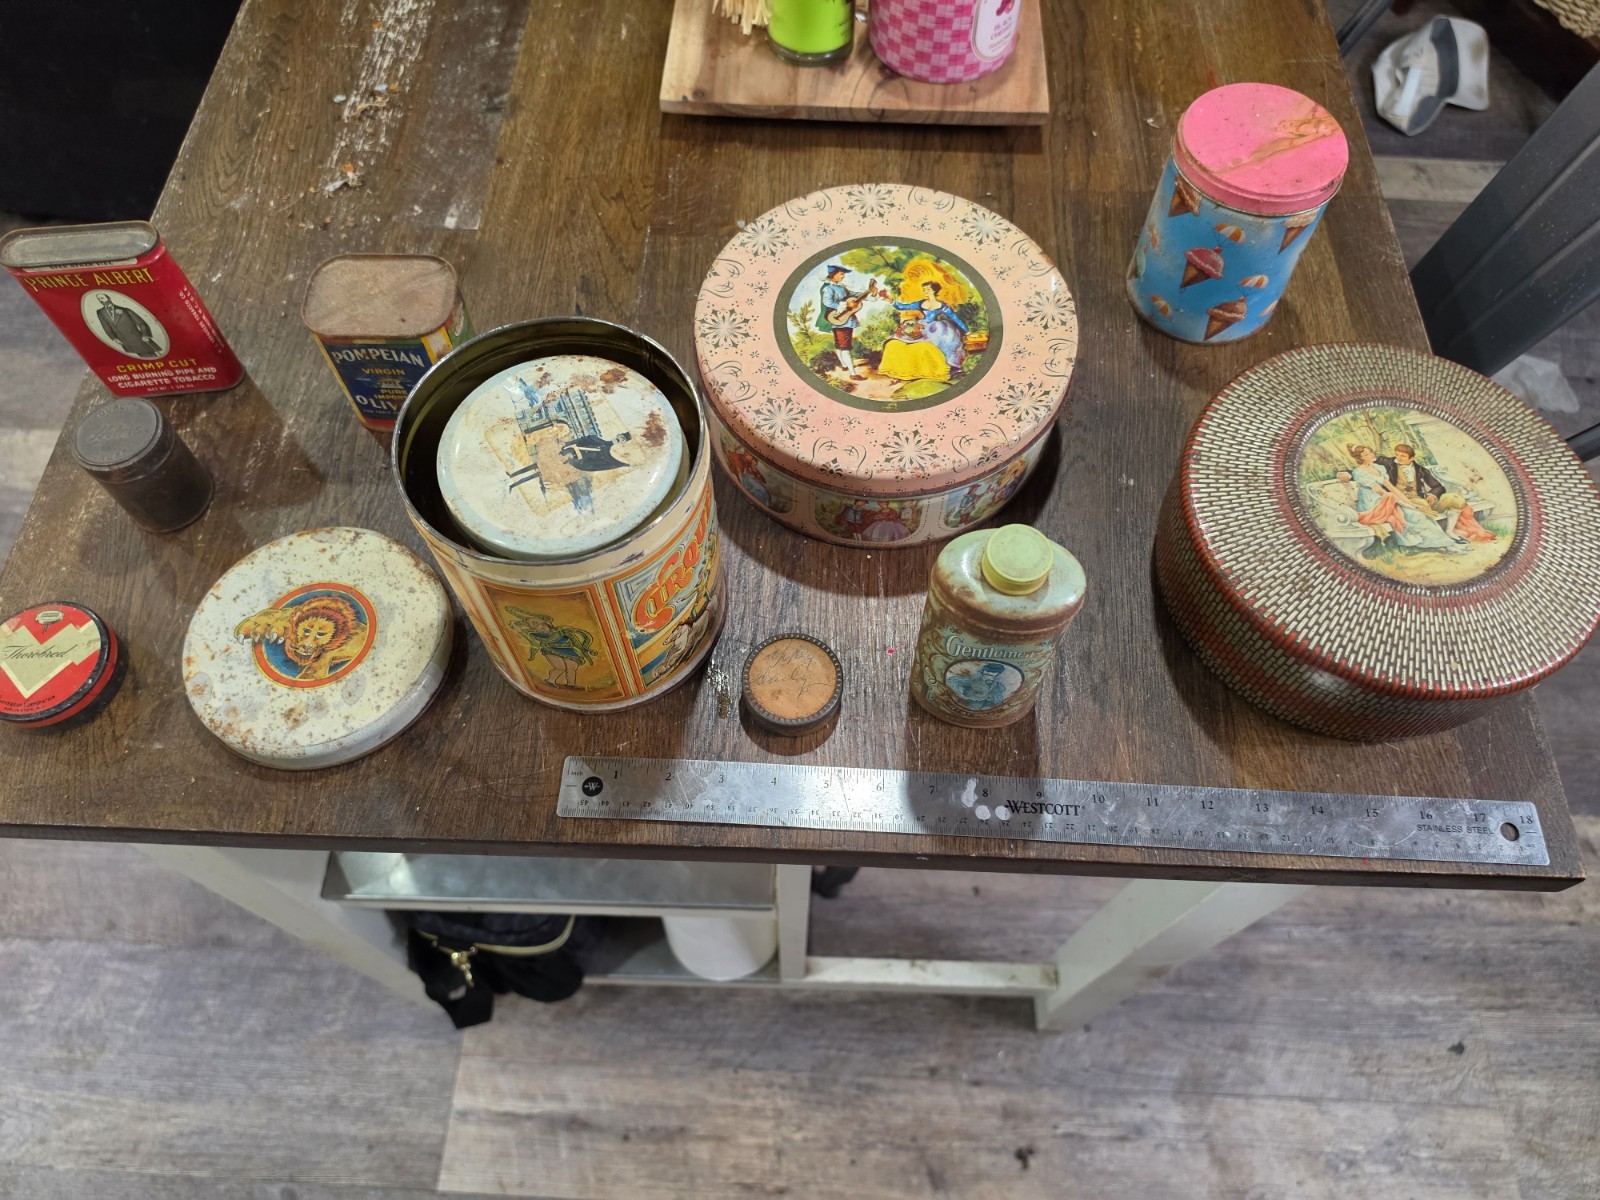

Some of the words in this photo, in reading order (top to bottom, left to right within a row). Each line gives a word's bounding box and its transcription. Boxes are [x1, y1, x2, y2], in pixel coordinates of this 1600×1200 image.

[23, 273, 89, 292] PRINCE
[93, 267, 154, 286] ALBERT
[116, 361, 165, 373] CRIMP
[168, 358, 197, 368] CUT
[331, 348, 425, 368] POMPEIAN
[107, 374, 131, 383] LONG
[132, 369, 174, 380] BURNING
[175, 367, 195, 376] PIPE
[198, 366, 217, 374] AND
[361, 368, 406, 376] VIRGIN
[118, 377, 171, 389] CIGARETTE
[172, 374, 216, 383] TOBACCO
[355, 395, 398, 411] OLIV
[613, 770, 618, 779] 1
[665, 772, 672, 781] 2
[719, 774, 725, 783] 3
[771, 777, 777, 786] 4
[823, 780, 830, 789] 5
[876, 783, 882, 791] 6
[929, 786, 936, 794] 7
[982, 789, 989, 797] 8
[1036, 791, 1043, 799] 9
[1092, 794, 1105, 803] 10
[1146, 797, 1159, 806] 11
[1201, 800, 1214, 810] 12
[1255, 803, 1269, 812] 13
[1311, 805, 1324, 815] 14
[1365, 808, 1379, 817] 15
[1420, 811, 1433, 820] 16
[1474, 813, 1486, 822] 17
[1520, 815, 1533, 824] 18
[1005, 800, 1081, 816] WESTCOTT
[1417, 824, 1463, 833] STAINLESS
[1466, 825, 1494, 835] STEEL
